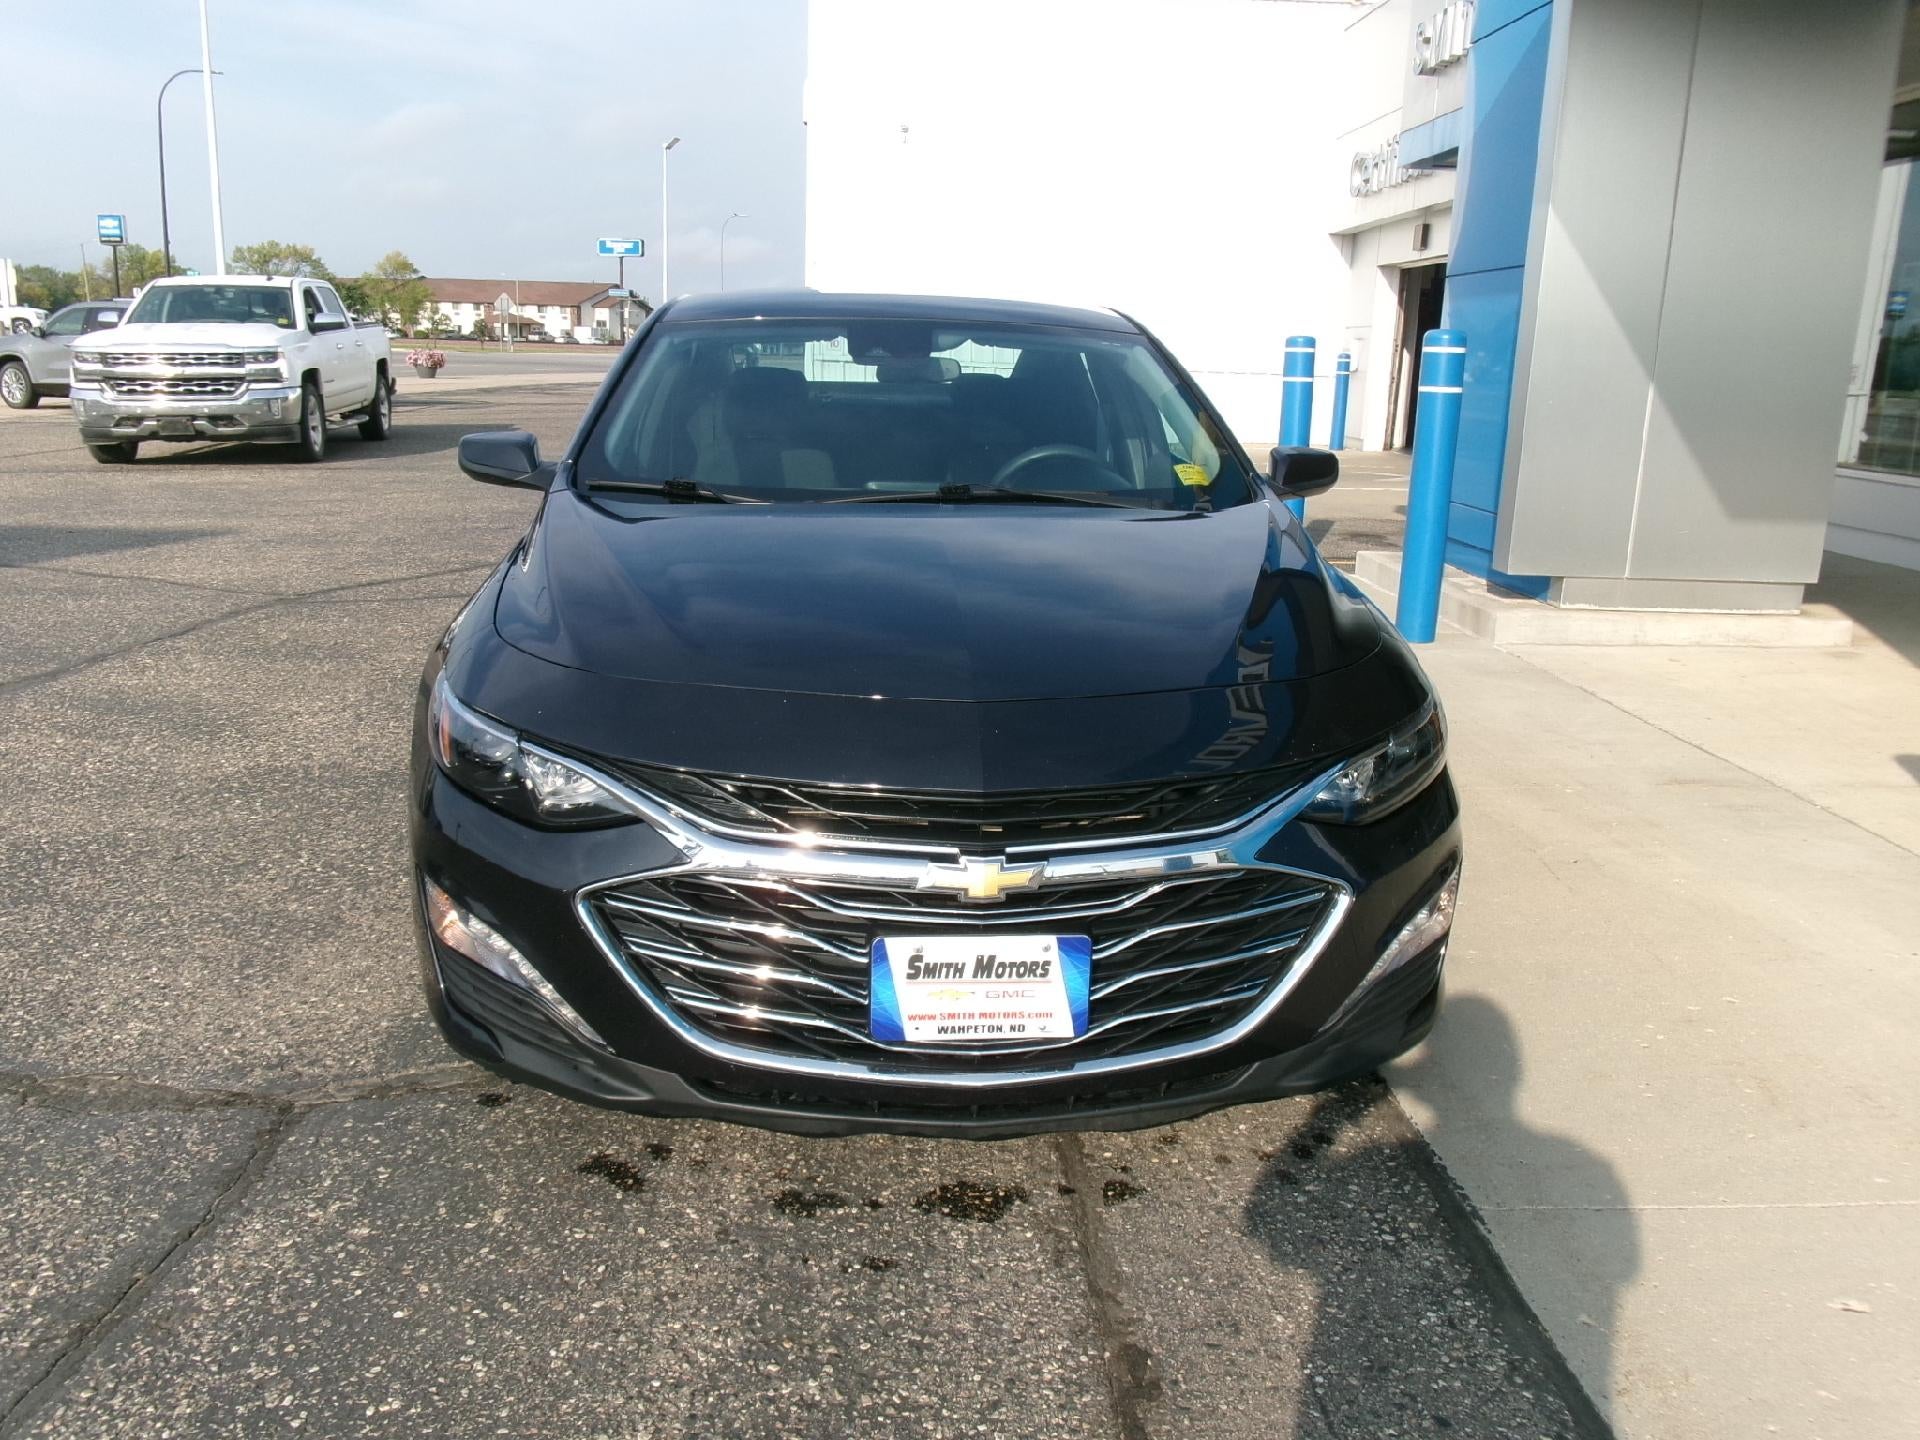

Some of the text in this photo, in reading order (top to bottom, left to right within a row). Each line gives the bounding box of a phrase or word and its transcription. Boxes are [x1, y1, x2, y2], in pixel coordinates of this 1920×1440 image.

[906, 954, 1052, 980] SMITH MOTORS
[985, 990, 1035, 999] GMC
[1009, 1024, 1026, 1033] ND
